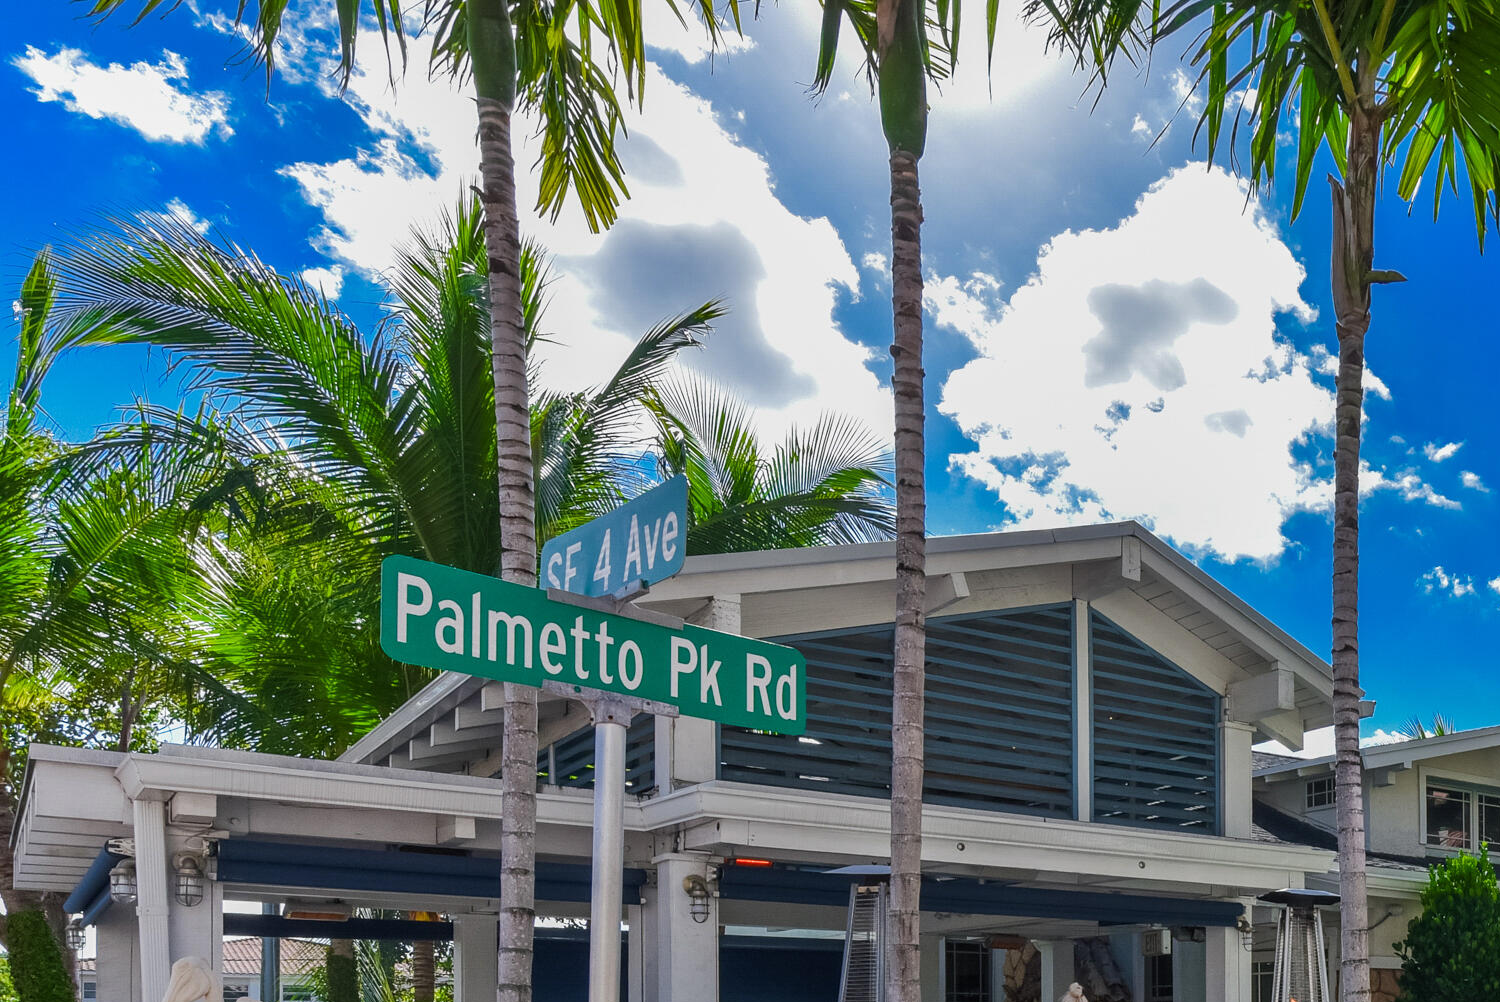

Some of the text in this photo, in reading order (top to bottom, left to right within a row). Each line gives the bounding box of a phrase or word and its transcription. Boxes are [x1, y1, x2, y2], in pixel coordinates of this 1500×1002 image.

[593, 528, 612, 592] 4
[623, 510, 679, 583] Ave
[396, 571, 798, 722] Palmetto Pk Rd
